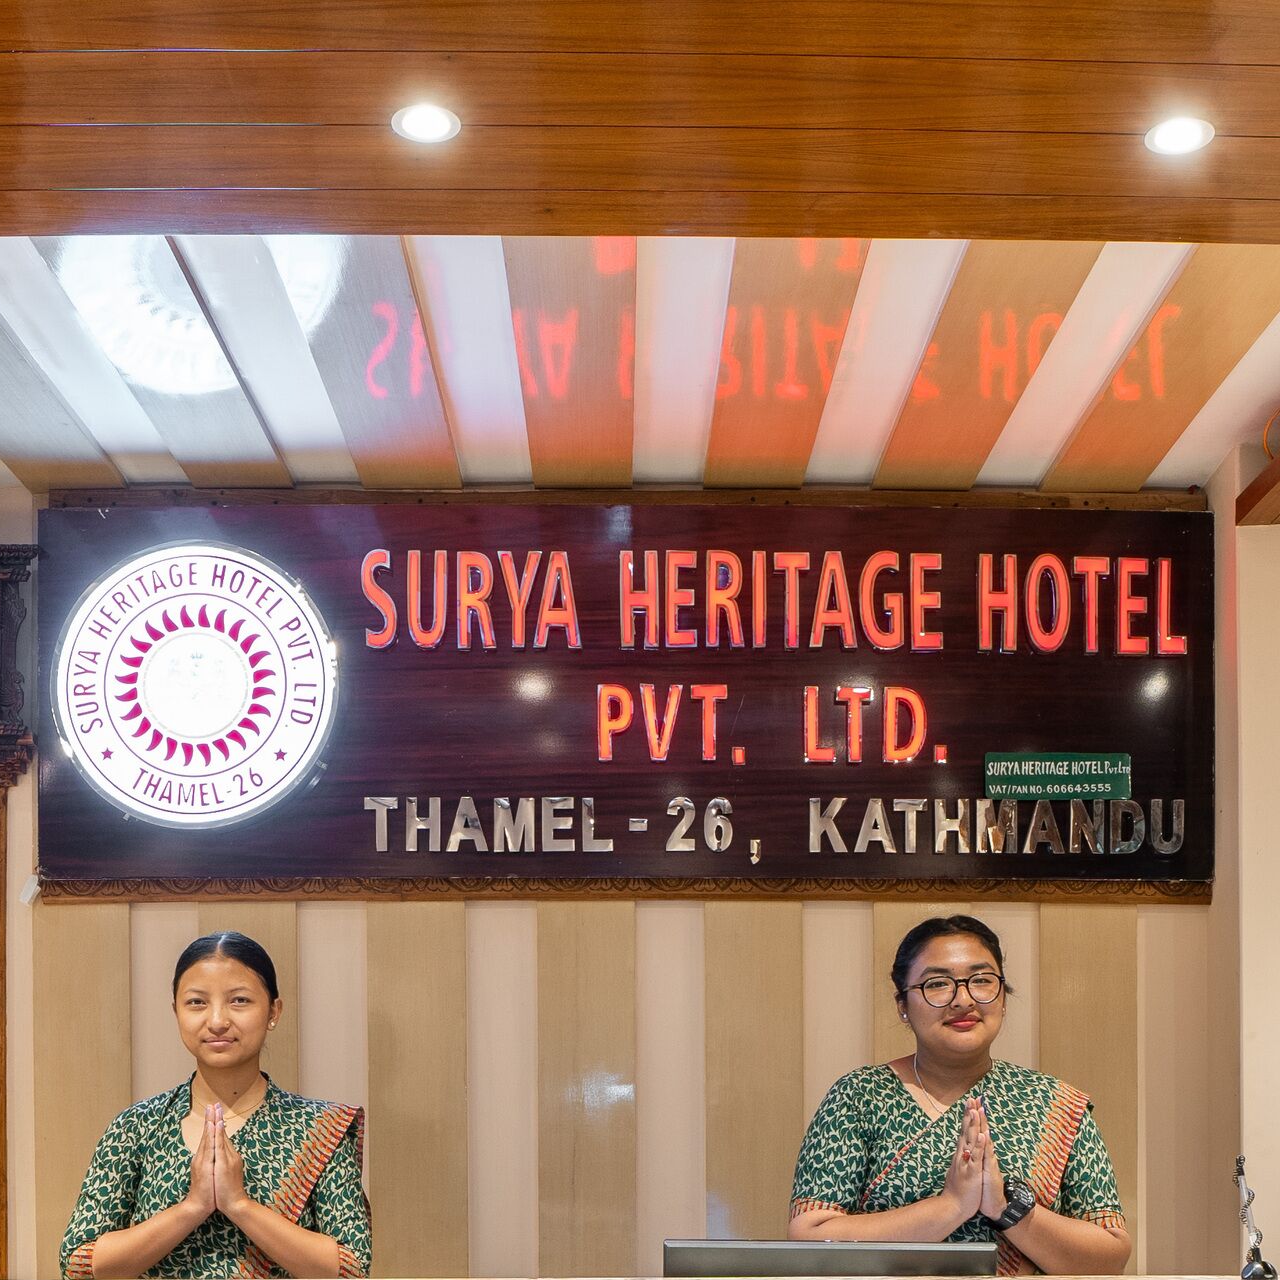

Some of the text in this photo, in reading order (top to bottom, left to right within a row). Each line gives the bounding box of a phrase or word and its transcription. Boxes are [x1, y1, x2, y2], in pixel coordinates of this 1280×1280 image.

[88, 562, 198, 640] HERITAGE
[212, 564, 284, 618] HOTEL
[363, 547, 1189, 657] SURYA HERITAGE HOTEL
[279, 616, 314, 670] PVT.
[73, 650, 104, 734] SURYA
[596, 682, 949, 767] PVT. LTD.
[132, 766, 263, 807] THAMEL-26
[987, 761, 1020, 776] SURYA
[1022, 761, 1069, 775] HERITAGE
[1072, 761, 1104, 775] HOTEL
[989, 784, 1028, 795] VAT/PAN
[809, 796, 1186, 856] KATHMANDU
